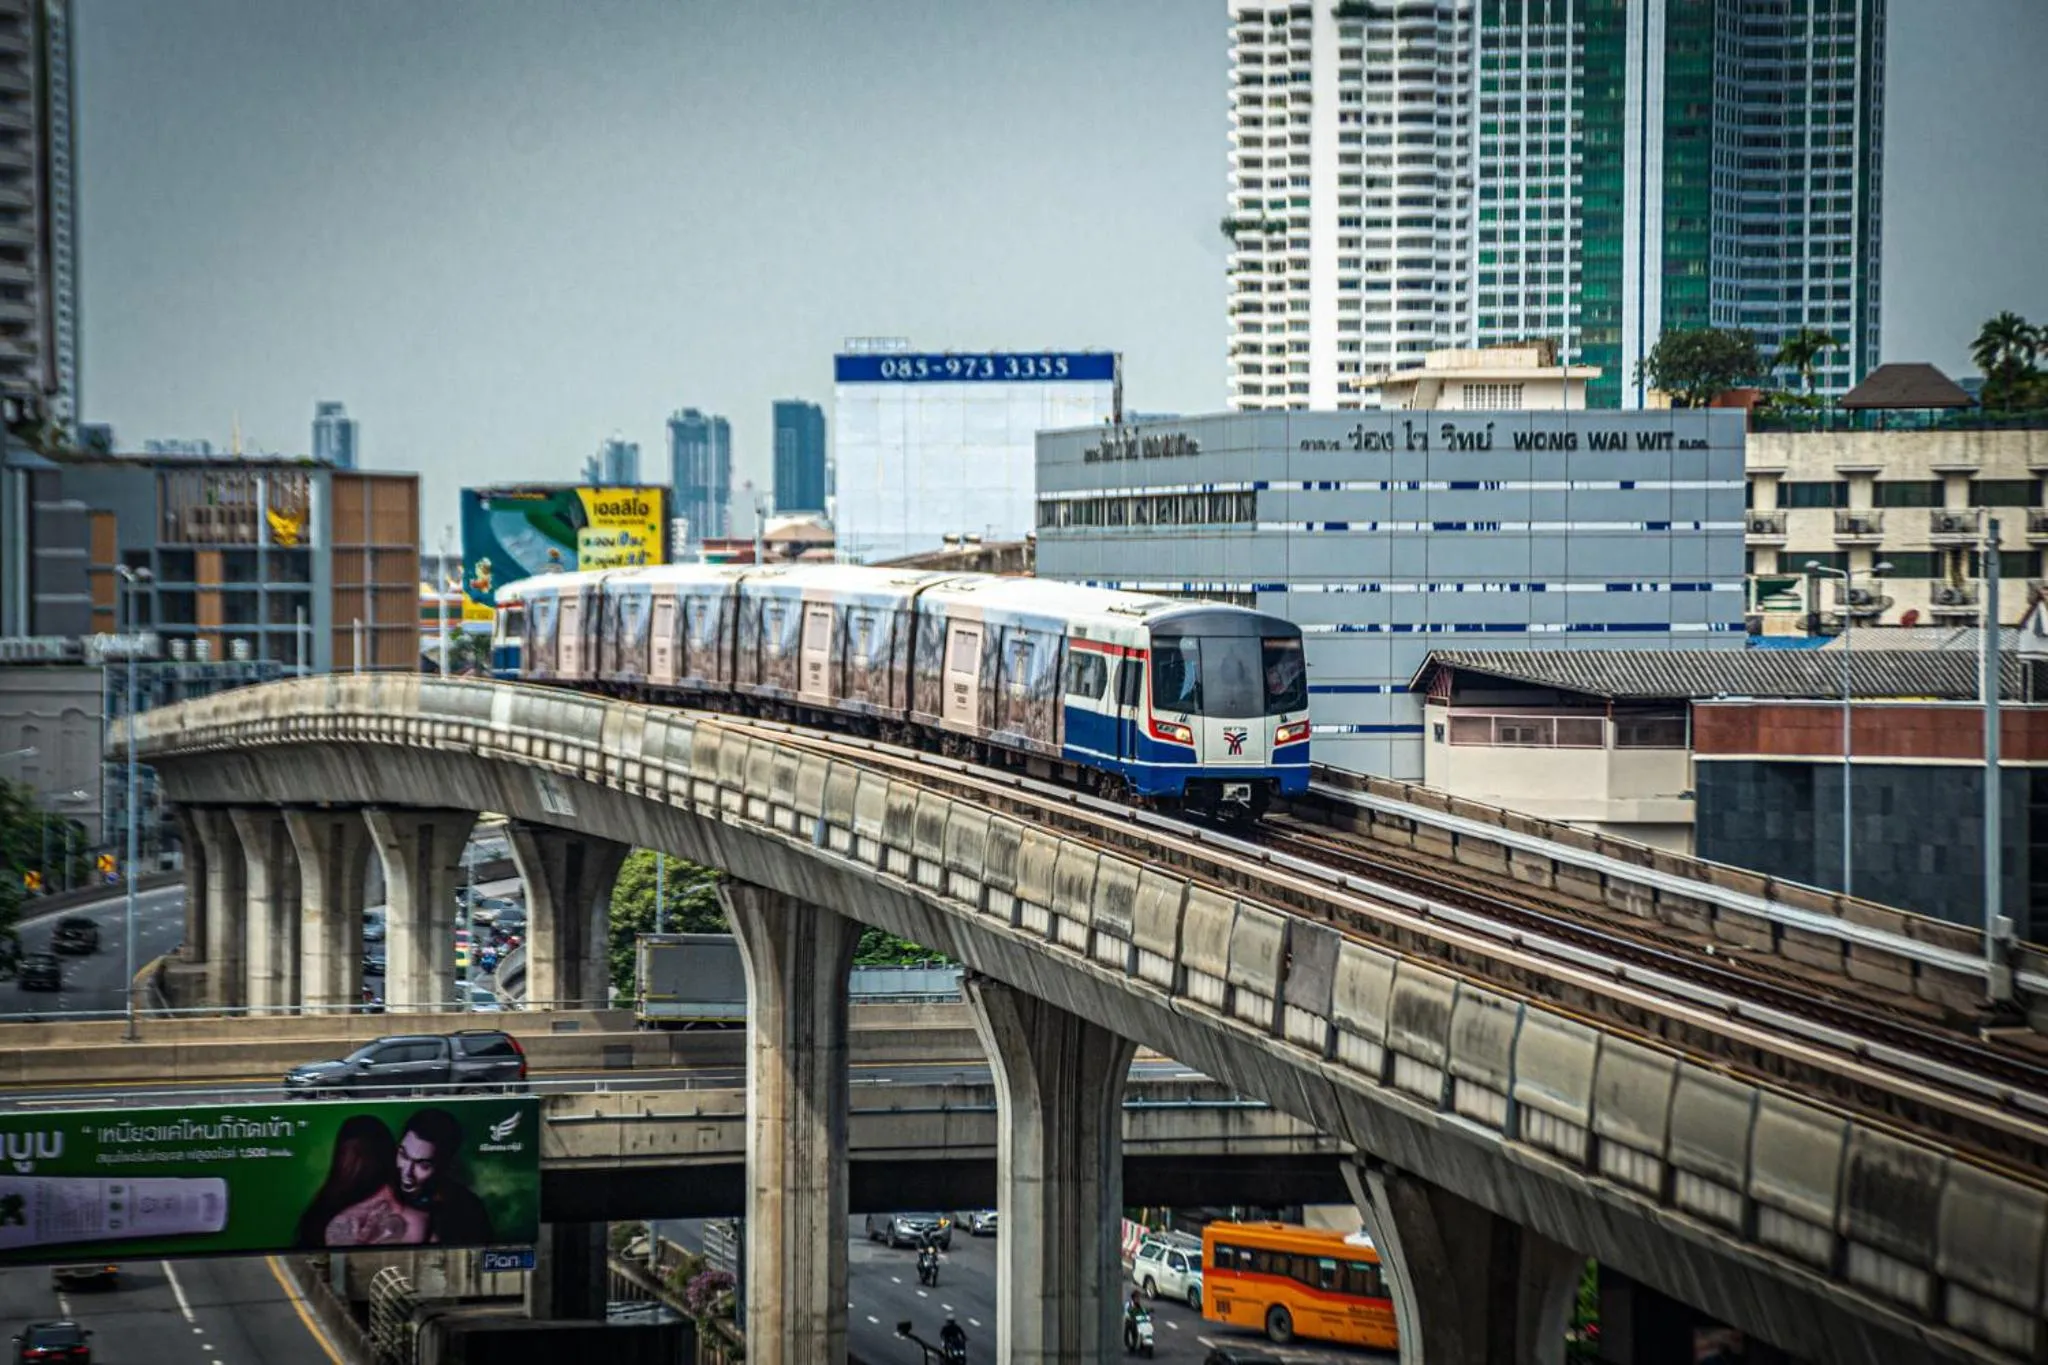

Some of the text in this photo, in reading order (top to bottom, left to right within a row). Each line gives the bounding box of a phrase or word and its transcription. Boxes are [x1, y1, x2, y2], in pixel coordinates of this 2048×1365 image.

[880, 357, 1070, 379] 085-973 3355
[1513, 431, 1578, 452] WONG
[1587, 431, 1629, 452] WAI
[1635, 431, 1675, 452] WIT
